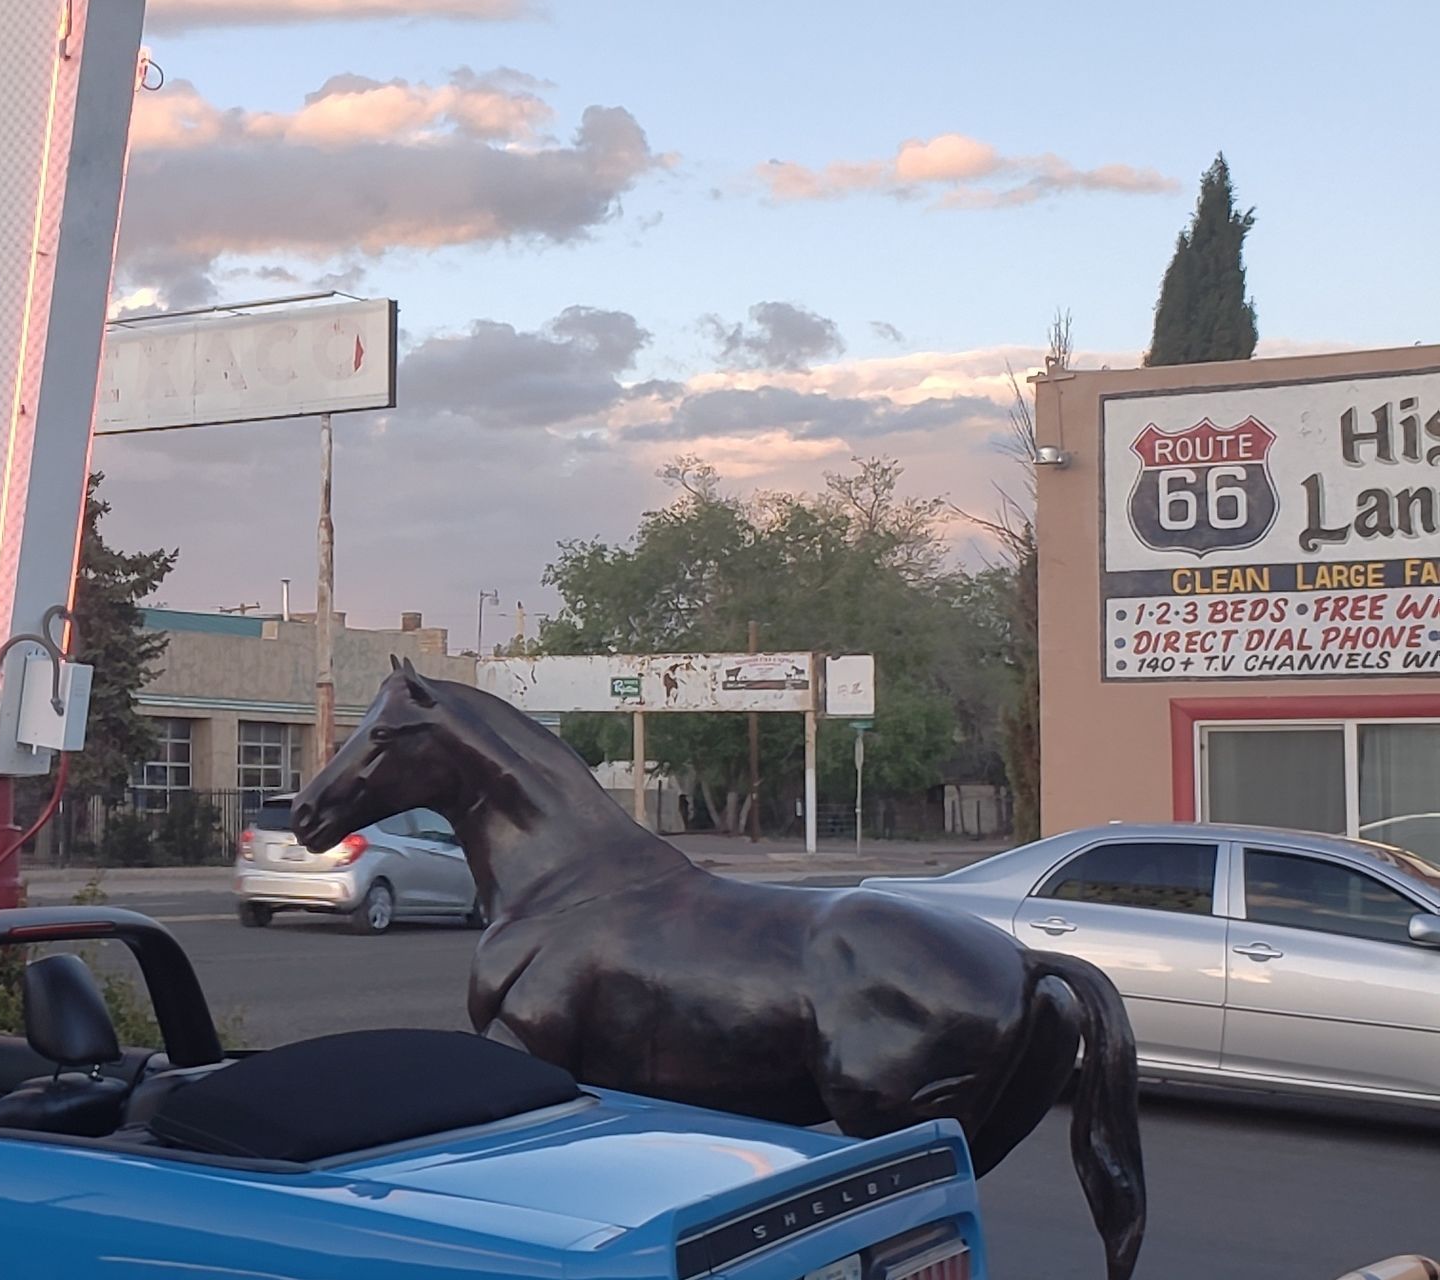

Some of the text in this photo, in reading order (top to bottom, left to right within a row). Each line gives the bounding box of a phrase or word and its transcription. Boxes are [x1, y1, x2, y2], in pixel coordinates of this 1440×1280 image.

[1154, 432, 1254, 464] ROUTE
[1158, 466, 1248, 531] 66
[1172, 567, 1270, 595] CLEAN
[1296, 562, 1386, 590] LARGE
[1207, 597, 1289, 624] BEDS
[1313, 593, 1388, 622] FREE
[1133, 624, 1426, 655] DIRECT DIAL PHONE
[1244, 650, 1392, 672] CHANNELS
[753, 1173, 901, 1240] SHELBY
